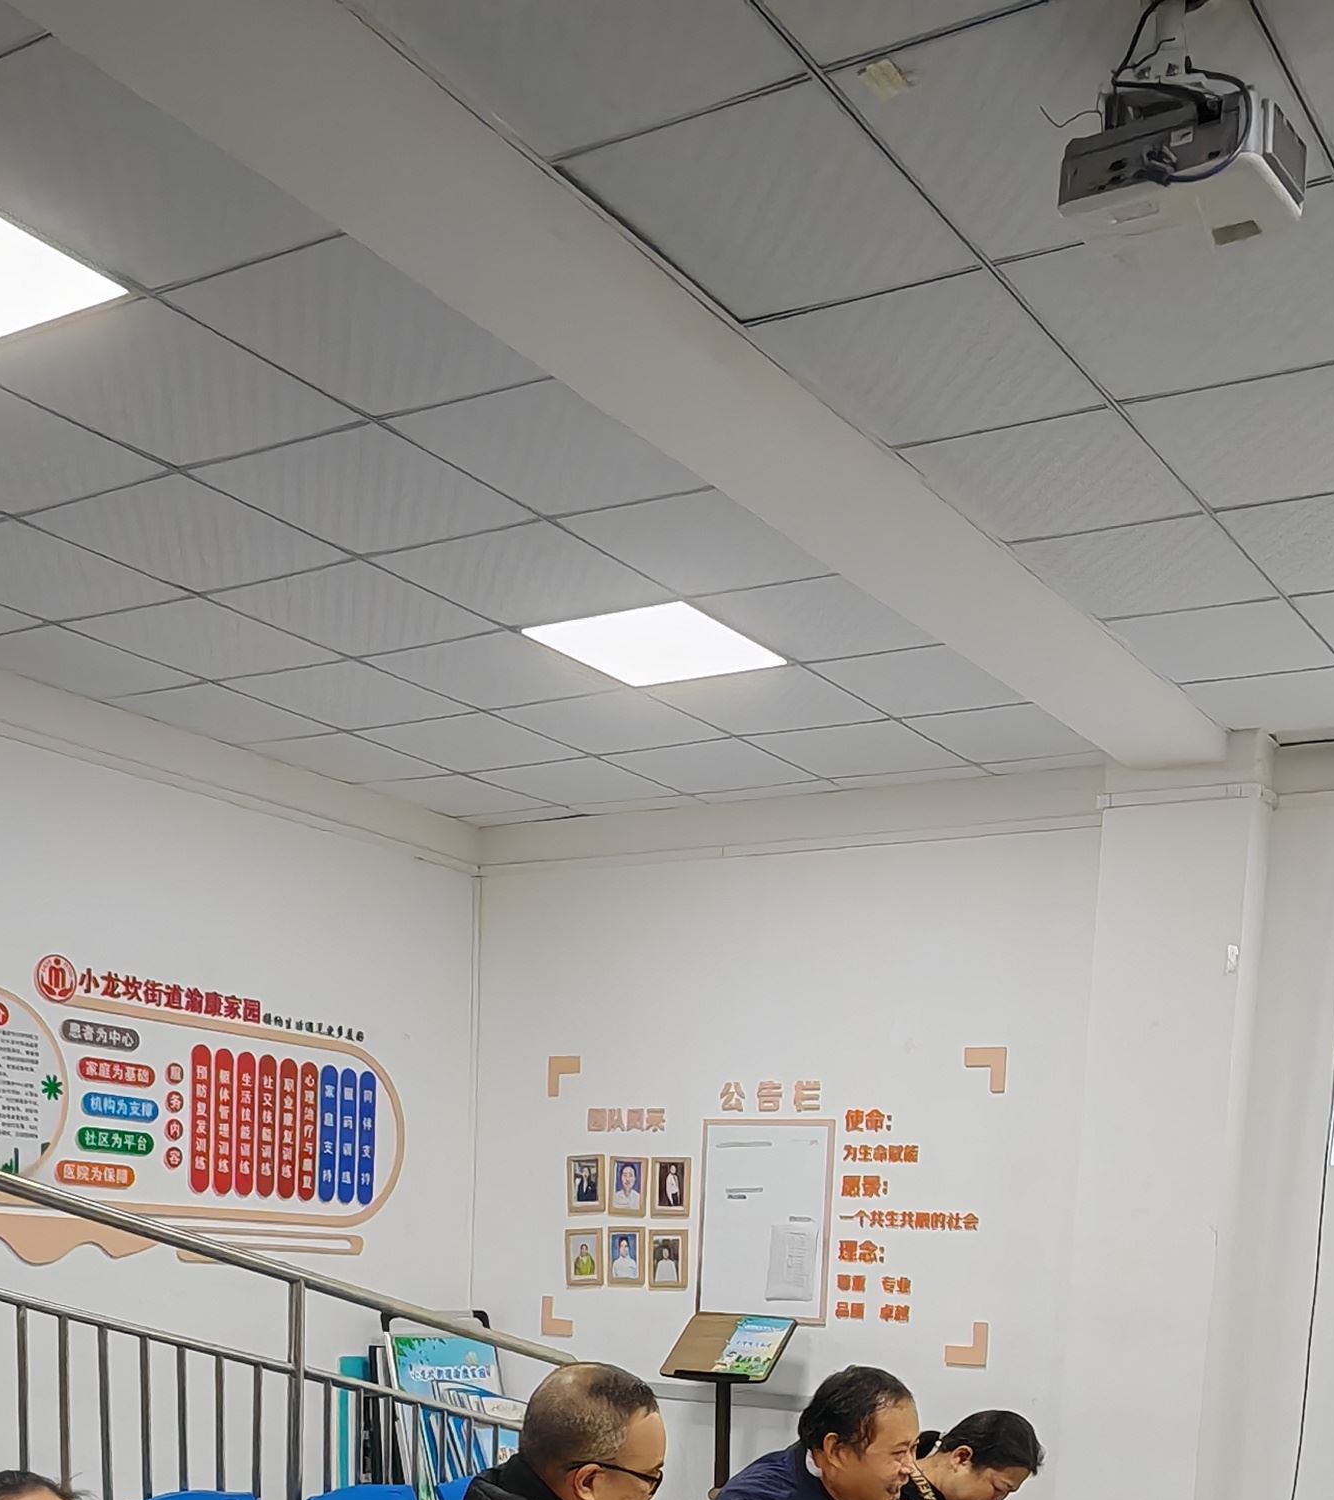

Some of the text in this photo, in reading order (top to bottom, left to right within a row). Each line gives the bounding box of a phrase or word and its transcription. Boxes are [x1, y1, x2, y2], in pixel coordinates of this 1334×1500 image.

[79, 967, 261, 1024] 小龙坎街道渝康家园
[69, 1022, 134, 1047] 患者为中心
[85, 1061, 150, 1083] 家庭为基础
[720, 1080, 821, 1113] 公告栏
[168, 1065, 182, 1166] 服务内容
[194, 1065, 208, 1171] 预防复发训练
[239, 1072, 252, 1175] 生活技能训练
[845, 1108, 892, 1133] 使命：
[84, 1130, 148, 1151] 社区为平台
[322, 1084, 335, 1183] 家庭支持
[843, 1144, 919, 1163] 为生命赋能
[63, 1163, 128, 1184] 医院为保障
[881, 1276, 911, 1294] 专业
